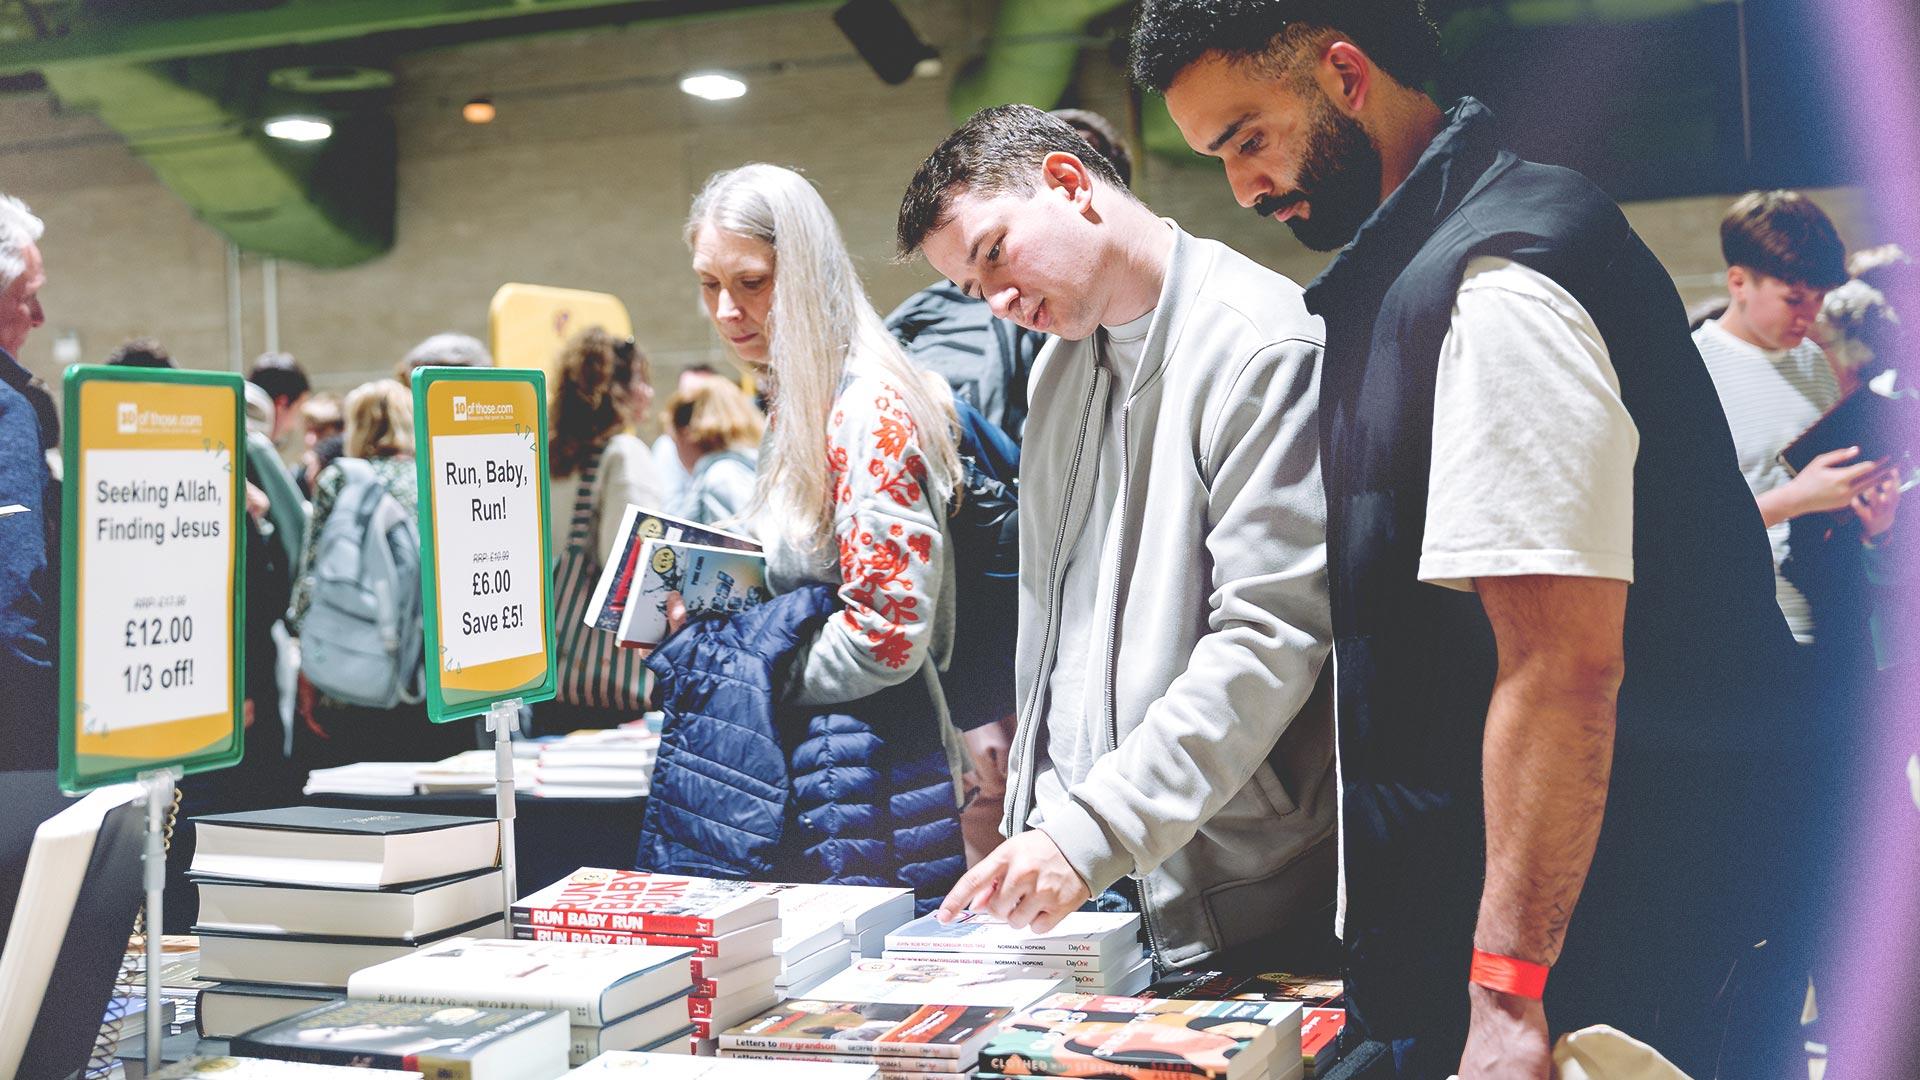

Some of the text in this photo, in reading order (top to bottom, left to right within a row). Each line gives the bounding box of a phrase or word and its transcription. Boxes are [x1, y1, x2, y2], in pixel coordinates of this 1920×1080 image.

[446, 460, 528, 489] Run, Baby,
[96, 480, 222, 508] Seeking Allah,
[471, 496, 507, 522] Run!
[97, 516, 221, 545] Finding Jesus
[472, 569, 511, 596] £6.00
[125, 616, 193, 647] £12.00
[461, 604, 524, 636] Save £5!
[122, 659, 195, 693] 1/3 off!
[533, 909, 564, 926] RUN
[567, 912, 609, 929] BABY
[612, 914, 644, 930] RUN
[1068, 943, 1091, 953] DayOne
[1066, 959, 1089, 968] DayOne
[736, 1038, 766, 1048] Letters
[767, 1040, 778, 1048] to
[778, 1041, 794, 1050] my
[794, 1041, 837, 1051] grandson
[991, 1058, 1048, 1071] CLOTHED
